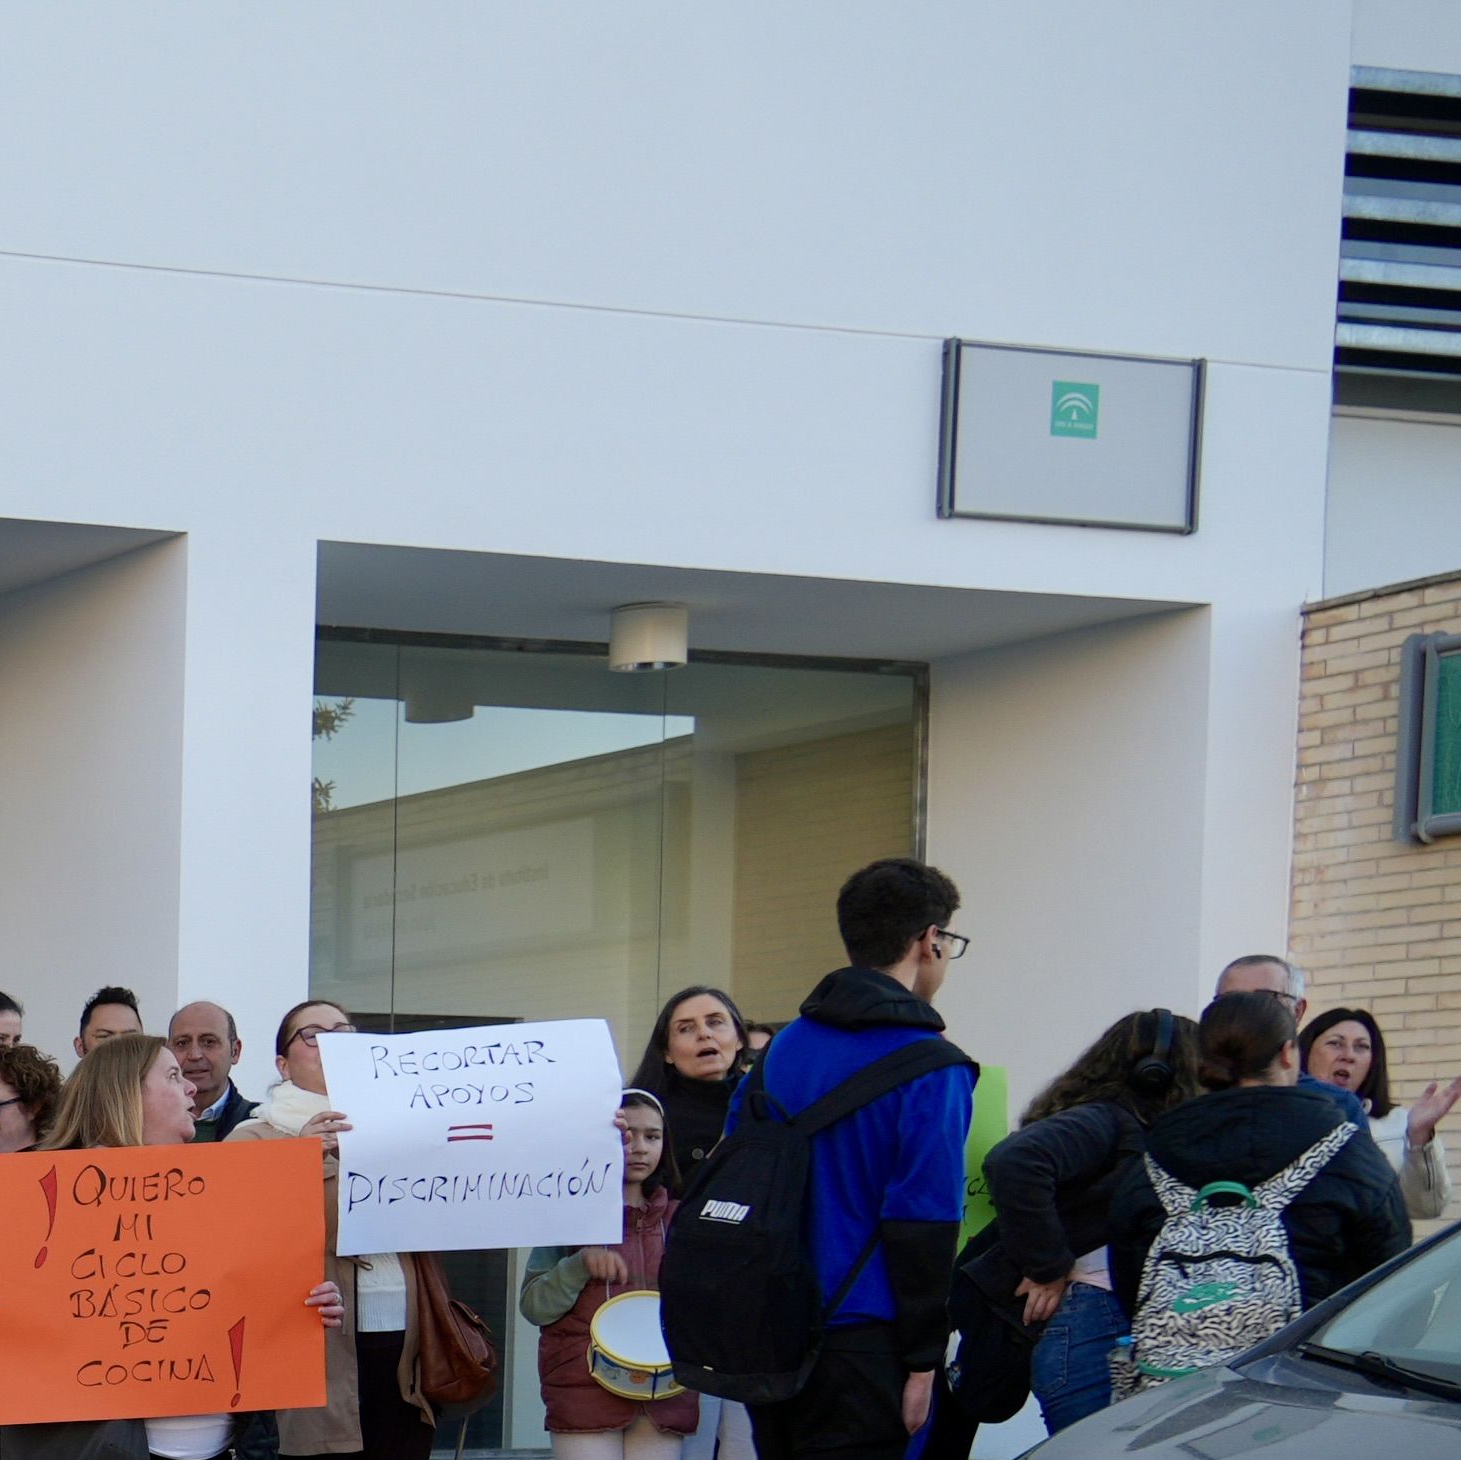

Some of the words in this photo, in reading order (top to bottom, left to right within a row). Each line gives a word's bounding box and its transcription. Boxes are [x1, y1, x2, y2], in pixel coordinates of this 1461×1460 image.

[370, 1040, 557, 1079] RECORTAR
[410, 1082, 535, 1109] APOYOS
[72, 1164, 206, 1207] QUIERO
[348, 1157, 612, 1213] DISCRIMINACIÓN
[700, 1199, 750, 1221] PUMA
[113, 1213, 154, 1242] MI
[71, 1248, 187, 1280] CICLO
[69, 1284, 211, 1318] BÁSICO
[119, 1318, 170, 1349] DE
[77, 1354, 215, 1387] COCINA
